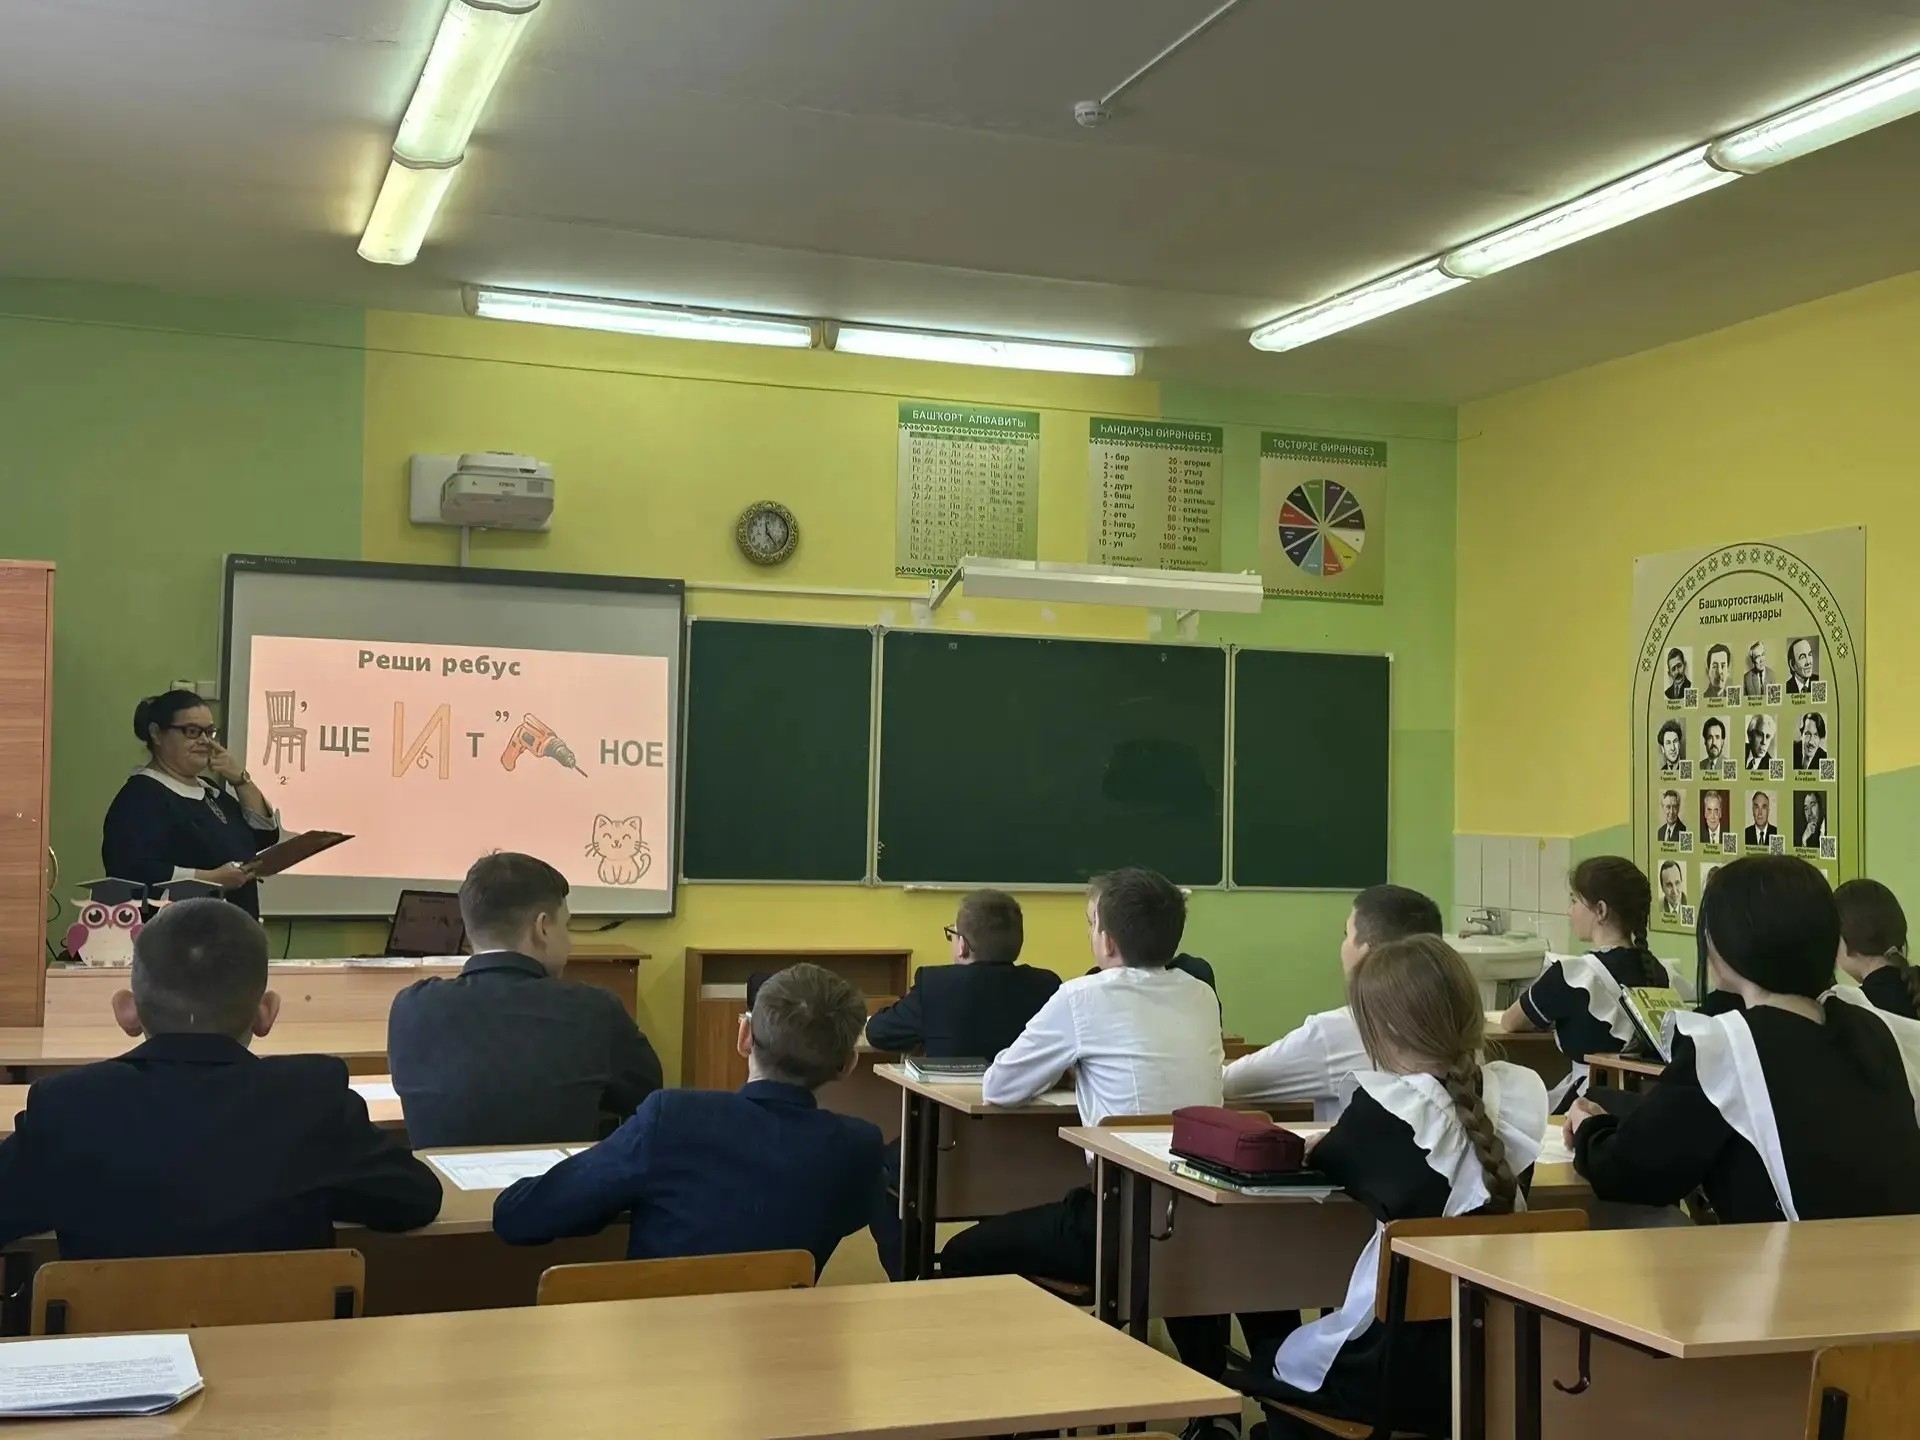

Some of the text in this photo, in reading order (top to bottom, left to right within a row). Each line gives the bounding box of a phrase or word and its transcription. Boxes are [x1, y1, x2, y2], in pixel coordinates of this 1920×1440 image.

[968, 414, 1027, 428] АЛФАВИТЫ
[1168, 457, 1178, 465] 20
[1168, 466, 1178, 474] 30
[1103, 471, 1108, 479] 3
[1168, 476, 1177, 484] 40
[1168, 485, 1177, 493] 50
[1103, 490, 1108, 498] 5
[1168, 504, 1177, 512] 70
[1163, 533, 1176, 541] 100
[358, 650, 521, 680] Реши ребус
[319, 701, 664, 780] ЩЕ И Т НОЕ
